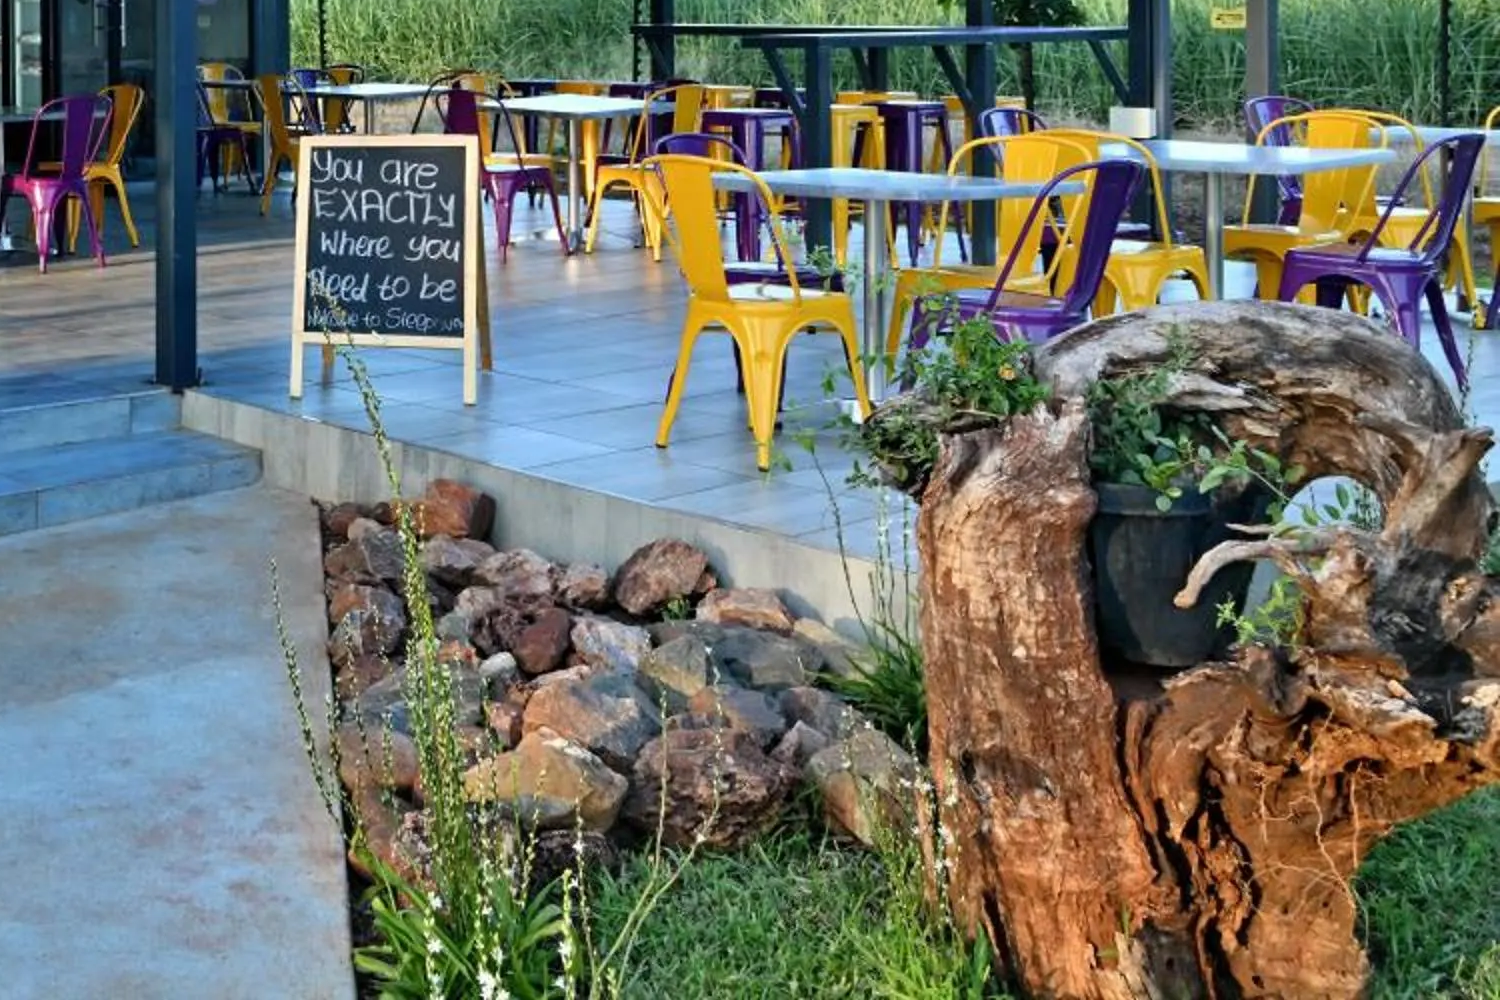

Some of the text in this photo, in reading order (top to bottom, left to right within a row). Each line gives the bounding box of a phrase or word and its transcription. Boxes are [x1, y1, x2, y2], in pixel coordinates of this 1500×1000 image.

[380, 159, 439, 189] are
[313, 187, 456, 227] EXACTLY
[403, 237, 460, 263] you
[377, 274, 410, 301] to
[419, 272, 457, 302] be
[361, 311, 381, 328] to
